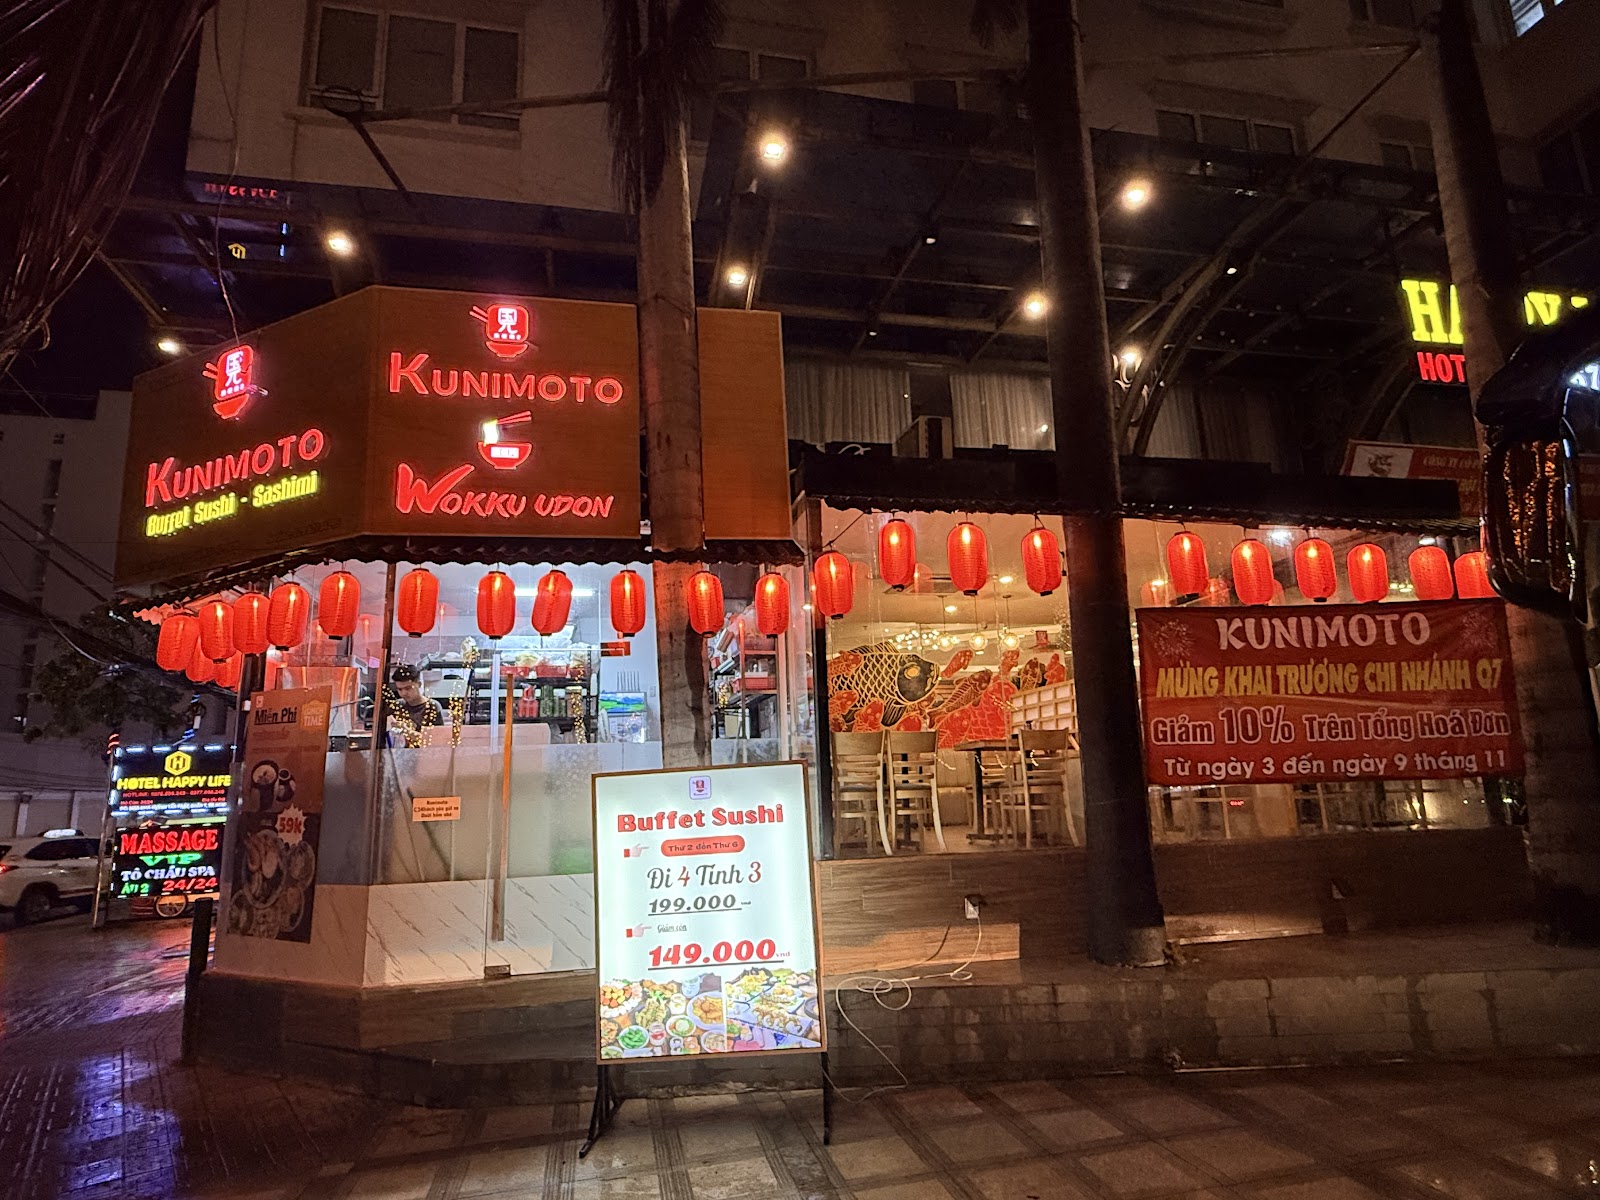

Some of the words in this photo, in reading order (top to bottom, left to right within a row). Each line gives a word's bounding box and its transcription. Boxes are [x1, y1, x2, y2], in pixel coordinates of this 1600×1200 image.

[390, 352, 623, 404] KUNIMOTO
[1416, 351, 1466, 382] HOT
[145, 428, 324, 507] KUNIMOTO
[194, 492, 236, 523] Sushi
[253, 470, 318, 507] Sashimi
[534, 495, 615, 518] UDON
[1215, 612, 1430, 650] KUNIMOTO
[1156, 659, 1219, 698] MỪNG
[1224, 665, 1272, 697] KHAI
[1364, 661, 1397, 693] CHI
[1401, 652, 1471, 692] NHÁNH
[303, 715, 324, 727] TIME
[1151, 714, 1215, 745] Giảm
[1219, 705, 1295, 744] 10%
[1303, 712, 1356, 742] Trên
[1358, 707, 1414, 742] Tổng
[1417, 709, 1467, 738] Hoá
[1469, 708, 1511, 736] Đơn
[1163, 757, 1191, 776] Từ
[1197, 756, 1254, 780] ngày
[1262, 757, 1275, 774] 3
[1282, 753, 1325, 774] đến
[1333, 753, 1387, 777] ngày
[1394, 753, 1407, 771] 9
[1414, 750, 1477, 772] tháng
[1484, 750, 1505, 767] 11
[117, 776, 160, 790] HOTEL
[162, 775, 207, 790] HAPPY
[208, 774, 232, 787] LIFE
[278, 817, 303, 835] 59k
[617, 809, 705, 833] Buffet
[711, 803, 784, 827] Sushi
[120, 829, 218, 855] MASSAGE
[121, 867, 142, 882] TÔ
[187, 865, 215, 877] SPA
[139, 852, 202, 867] VIP
[140, 883, 149, 893] 2
[162, 876, 218, 891] 24/24
[647, 867, 673, 889] Đi
[677, 866, 690, 887] 4
[748, 861, 761, 883] 3
[649, 894, 737, 913] 199.000
[648, 938, 776, 967] 149.000
